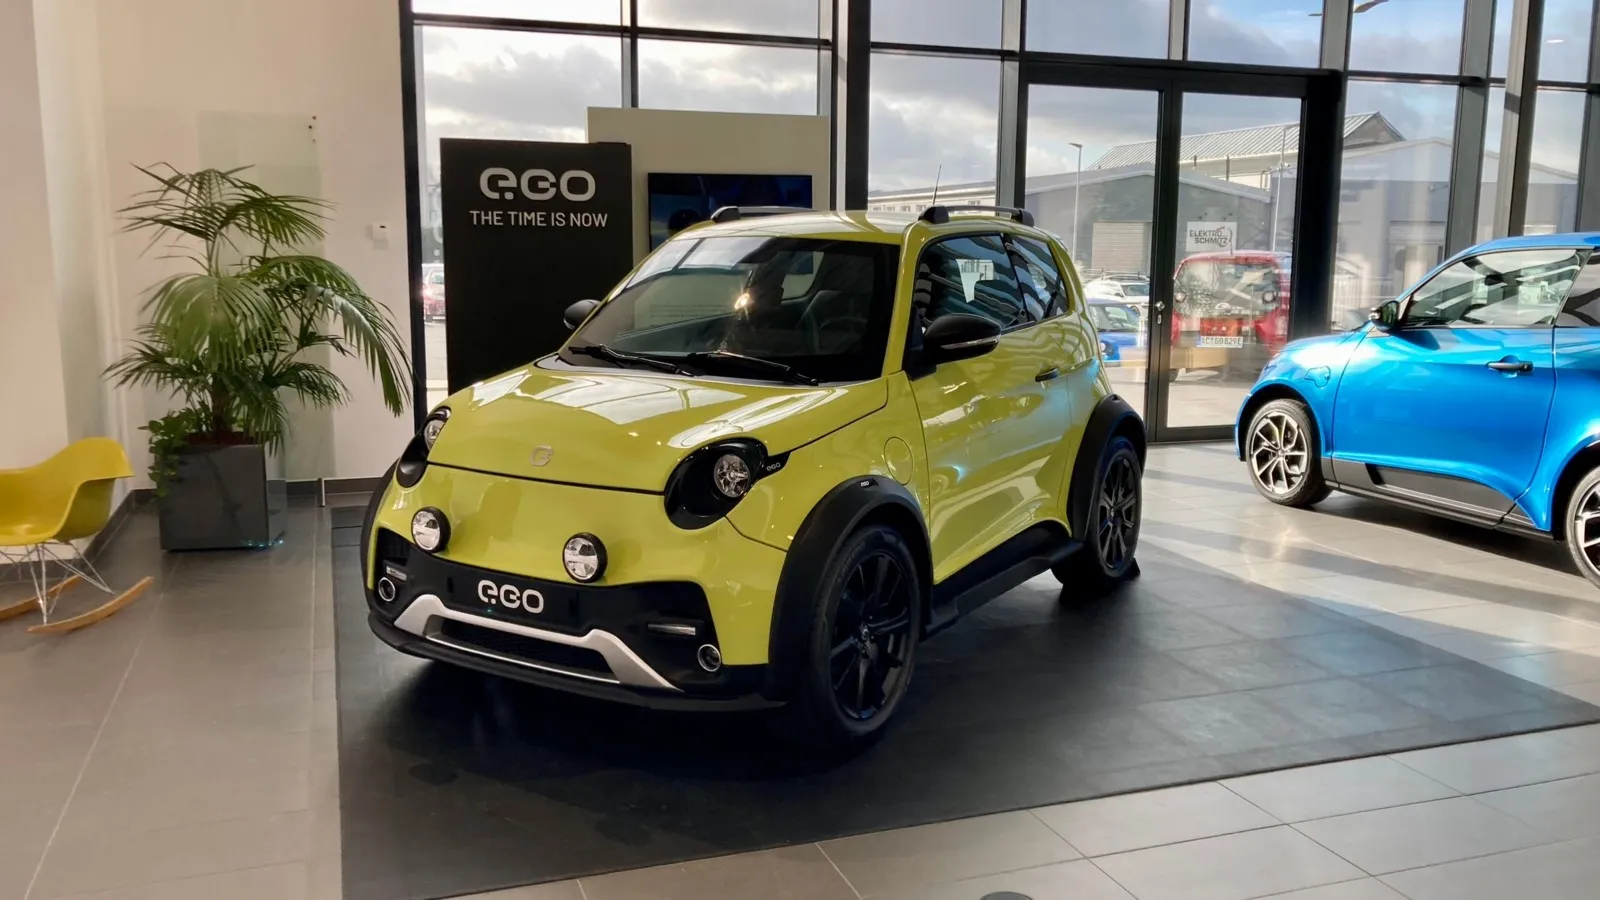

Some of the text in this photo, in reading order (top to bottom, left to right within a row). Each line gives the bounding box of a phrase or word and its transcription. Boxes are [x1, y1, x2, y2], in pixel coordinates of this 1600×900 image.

[469, 210, 608, 228] THE TIME IS NOW
